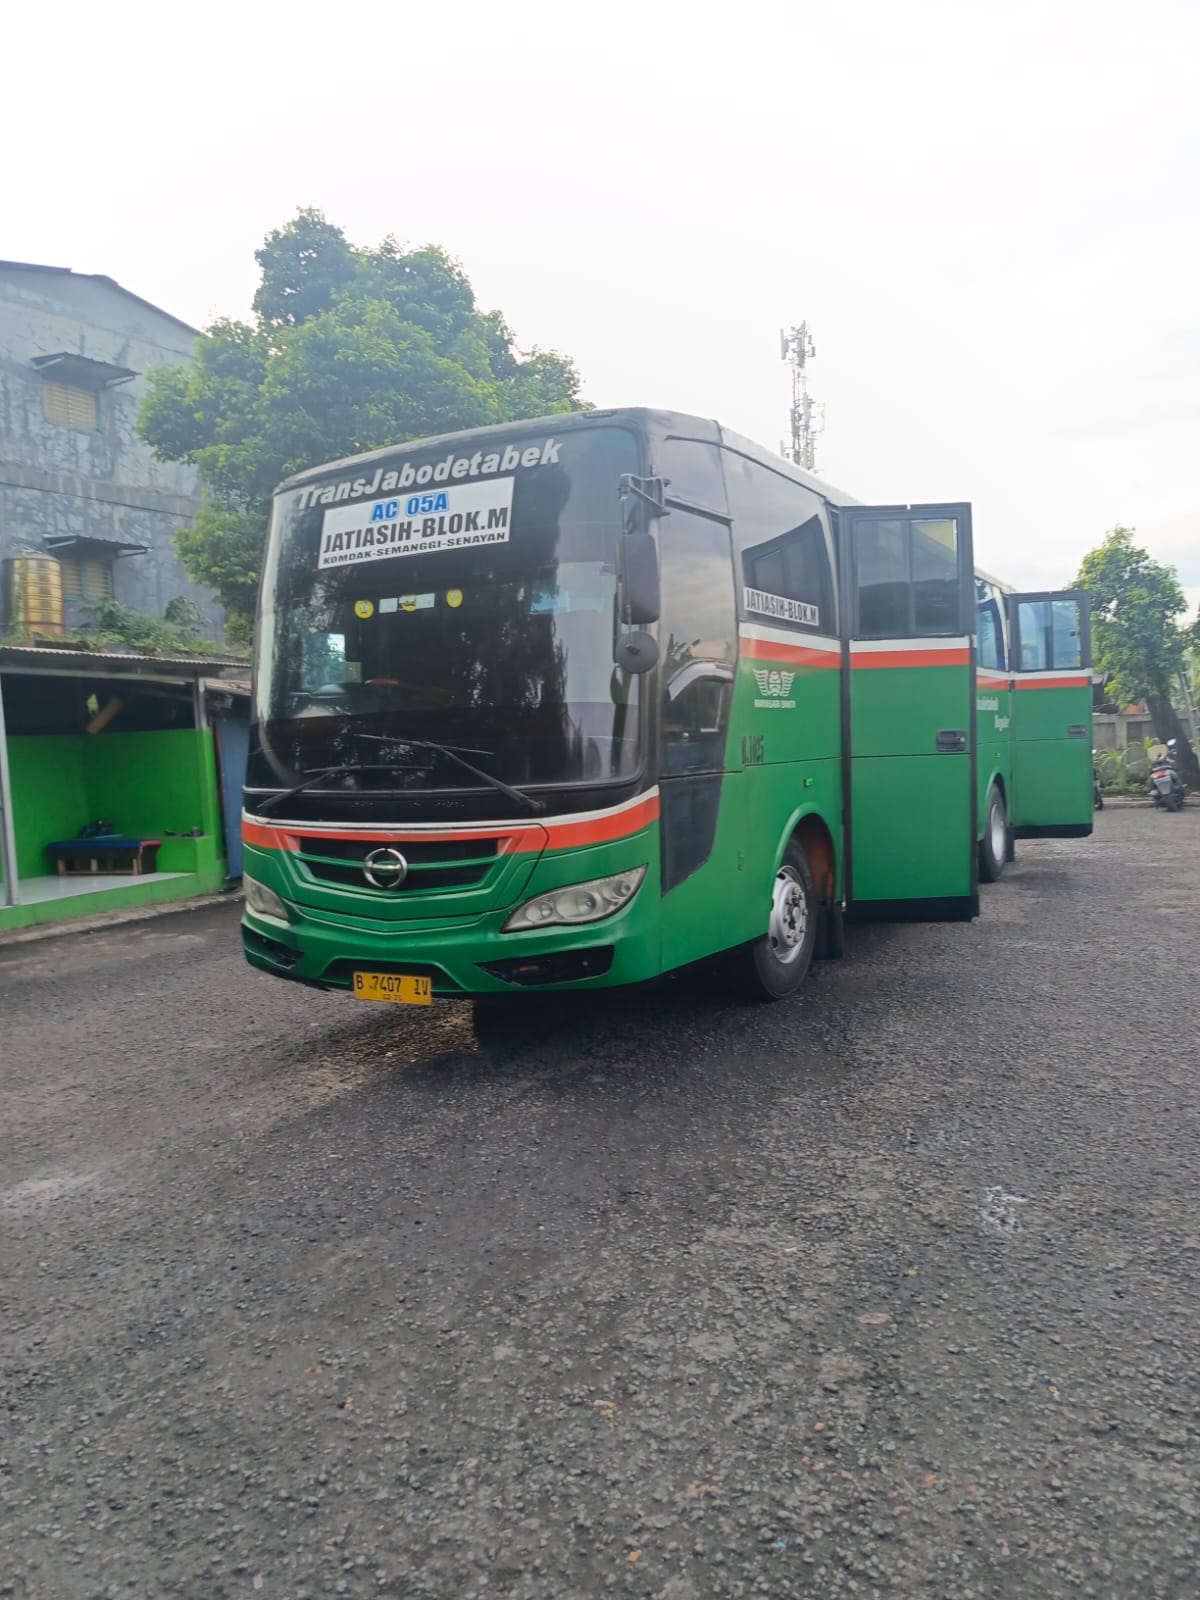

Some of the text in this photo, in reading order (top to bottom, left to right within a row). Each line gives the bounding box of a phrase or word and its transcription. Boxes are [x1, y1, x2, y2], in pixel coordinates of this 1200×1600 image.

[298, 438, 563, 511] TransJabodetabek
[370, 491, 449, 523] AC 05A
[322, 507, 509, 554] JATIASIH-BLOK.M
[323, 532, 506, 565] KOMDAK-SEMANGGI-SENAYAN
[356, 974, 364, 990] B
[370, 975, 402, 993] 7407
